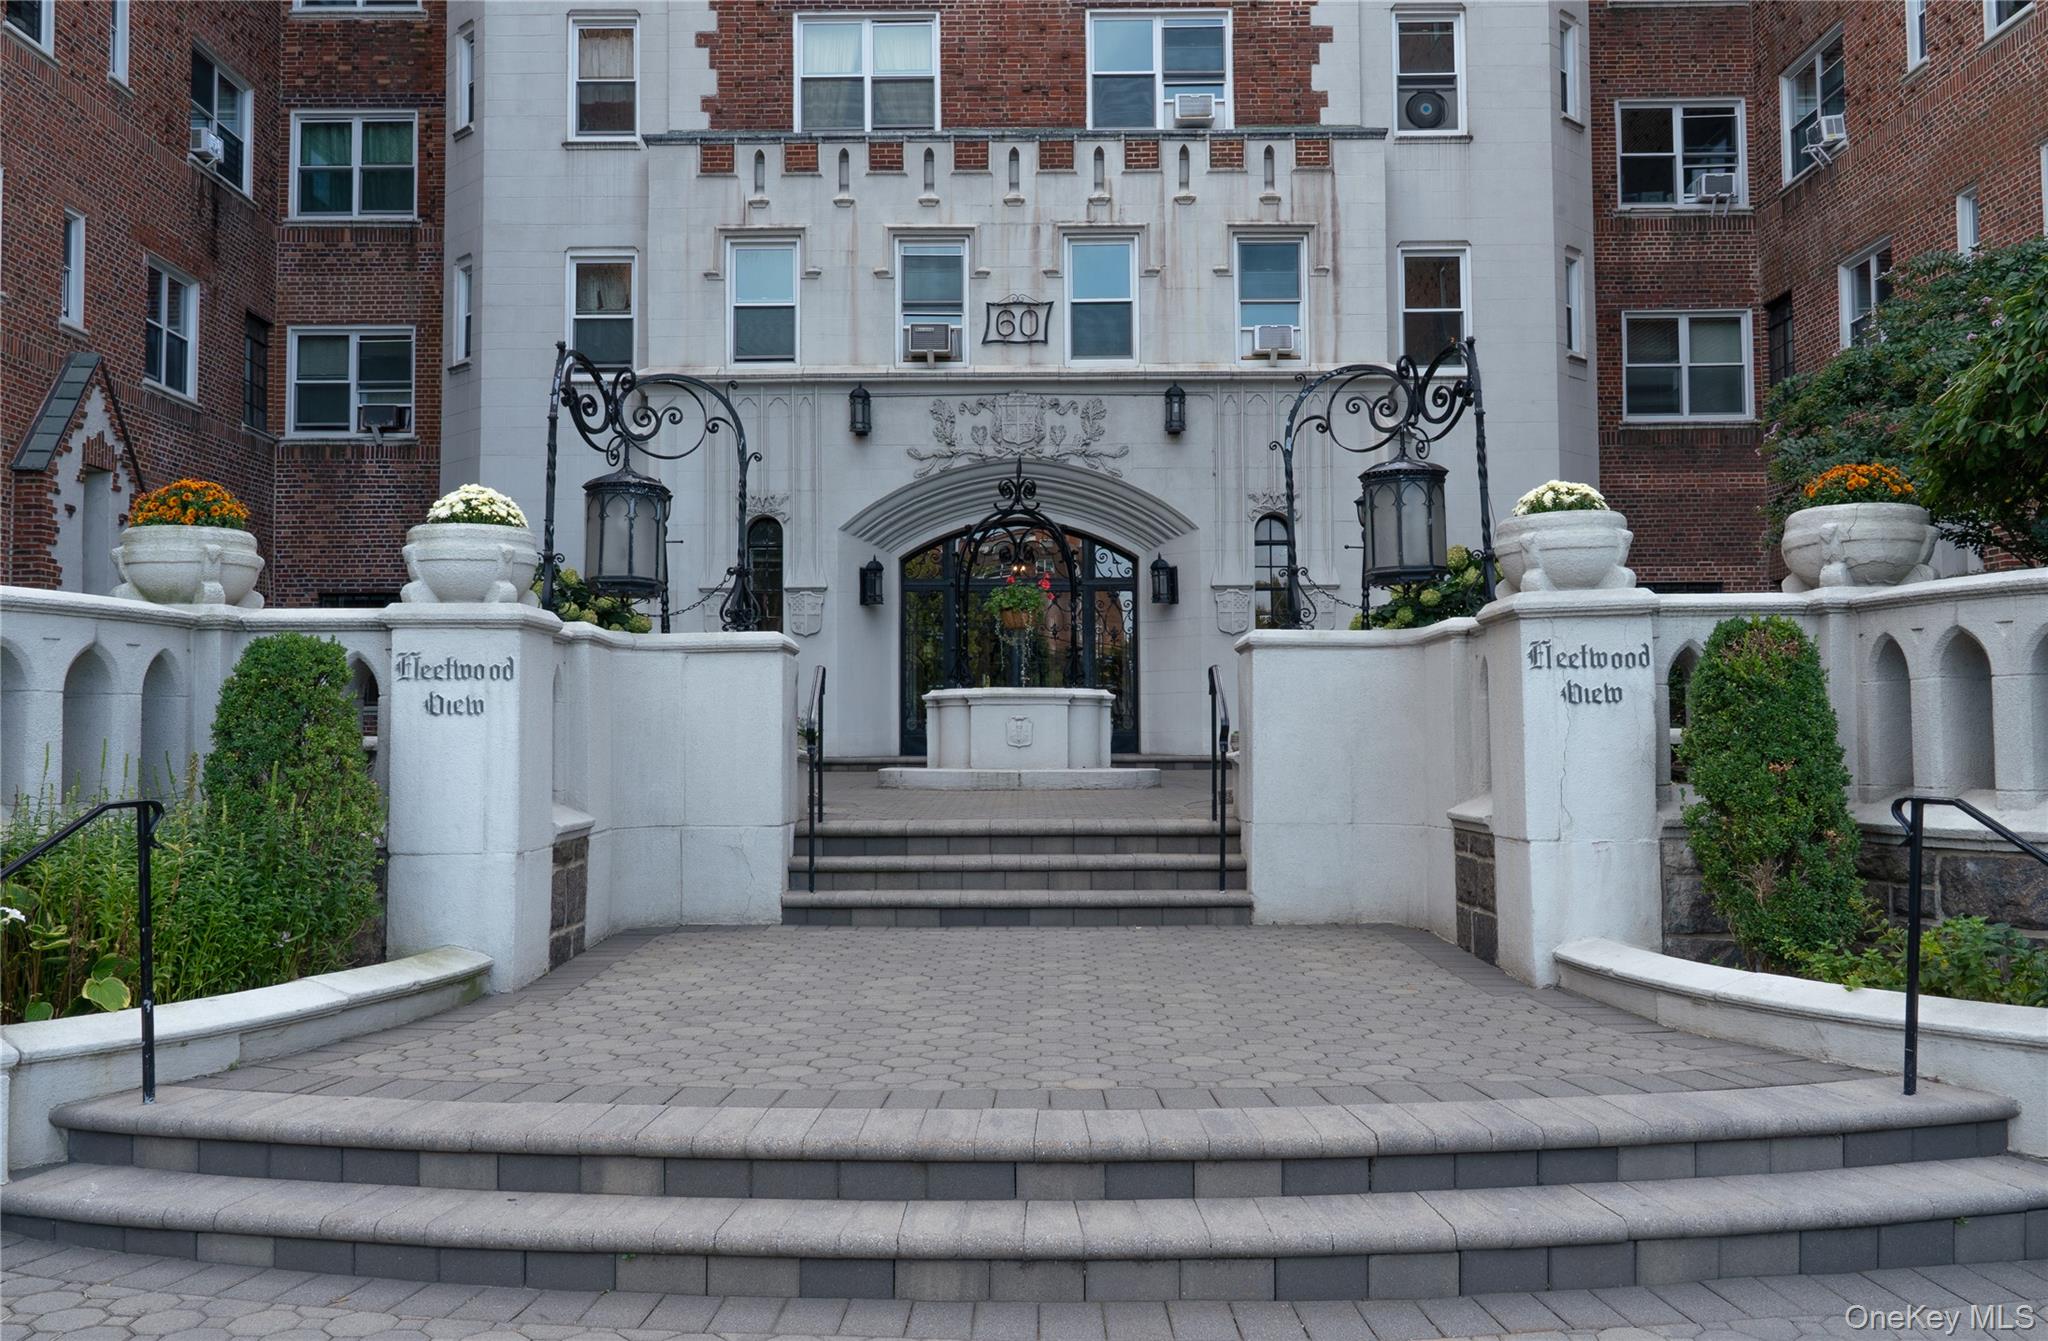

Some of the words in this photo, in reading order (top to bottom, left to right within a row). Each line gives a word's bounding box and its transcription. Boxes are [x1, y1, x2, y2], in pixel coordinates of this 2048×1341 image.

[996, 309, 1039, 337] 60
[396, 651, 515, 681] Fleetwood
[1527, 638, 1650, 670] Fleetwood
[424, 690, 485, 717] View
[1560, 679, 1623, 705] View
